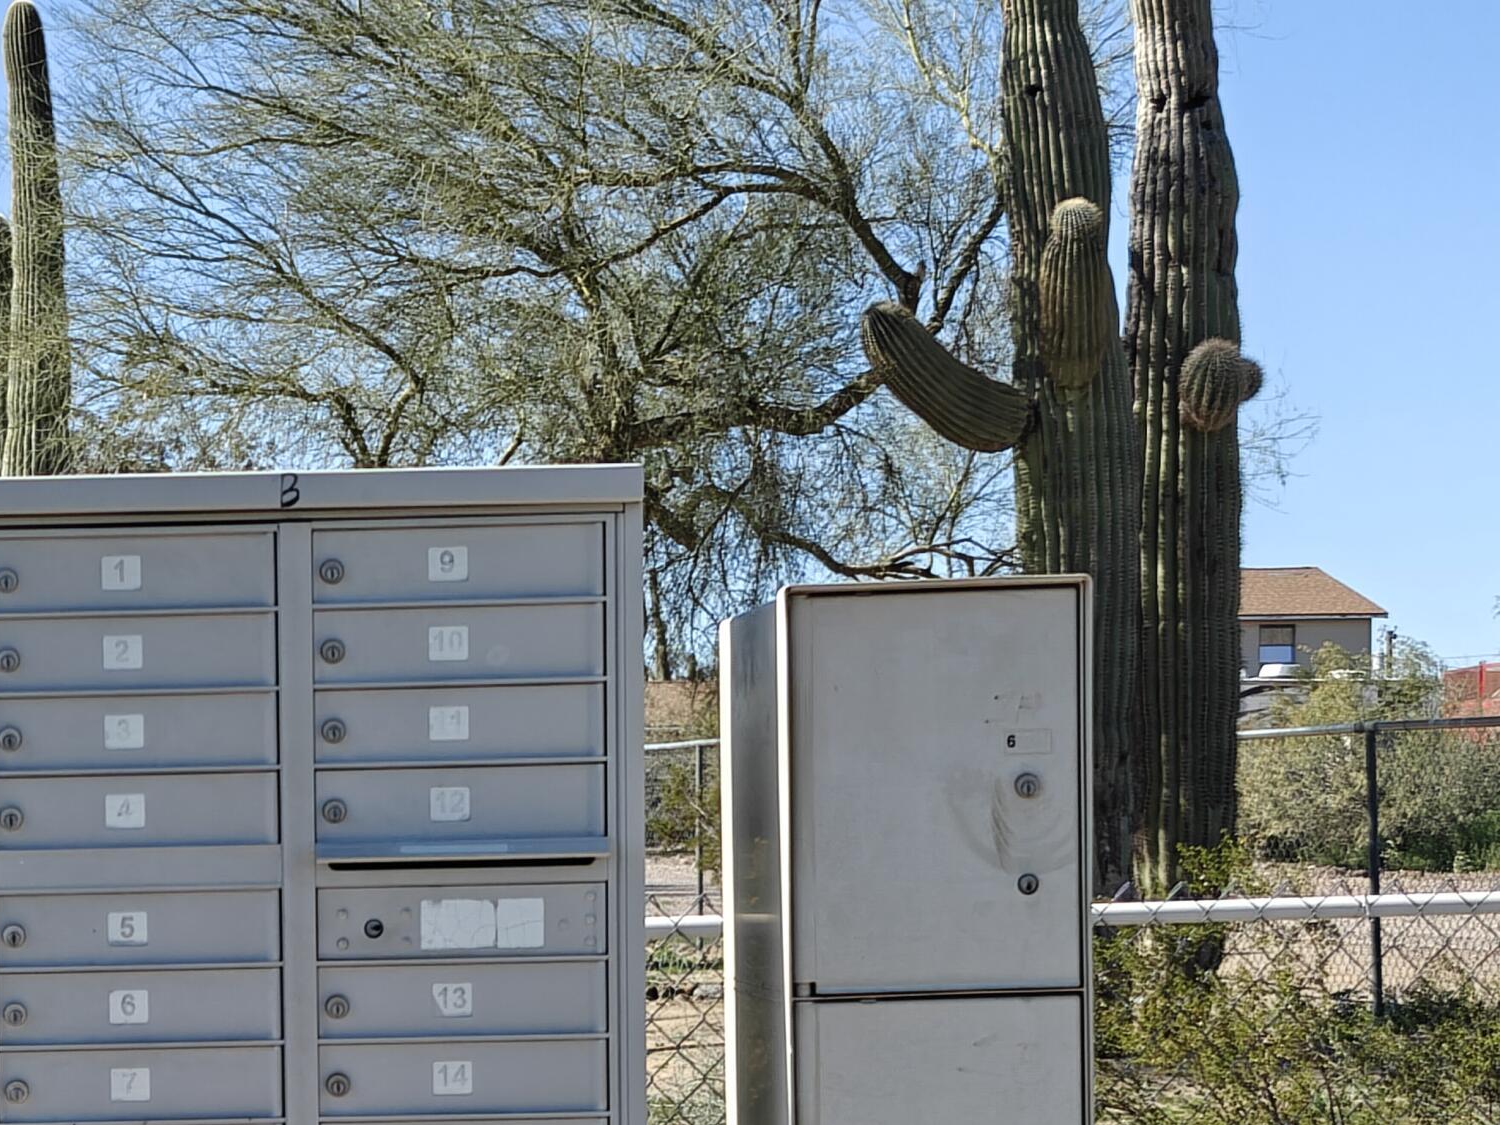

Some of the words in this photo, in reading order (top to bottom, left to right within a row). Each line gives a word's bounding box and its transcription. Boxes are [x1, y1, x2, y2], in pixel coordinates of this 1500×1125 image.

[280, 473, 300, 508] B
[113, 559, 125, 583] 1
[440, 550, 455, 574] 9
[115, 639, 130, 662] 2
[1006, 734, 1016, 748] 6
[120, 914, 135, 939] 5
[121, 993, 136, 1017] 6
[438, 985, 467, 1010] 13
[120, 1071, 137, 1096] 7
[438, 1063, 468, 1088] 14
